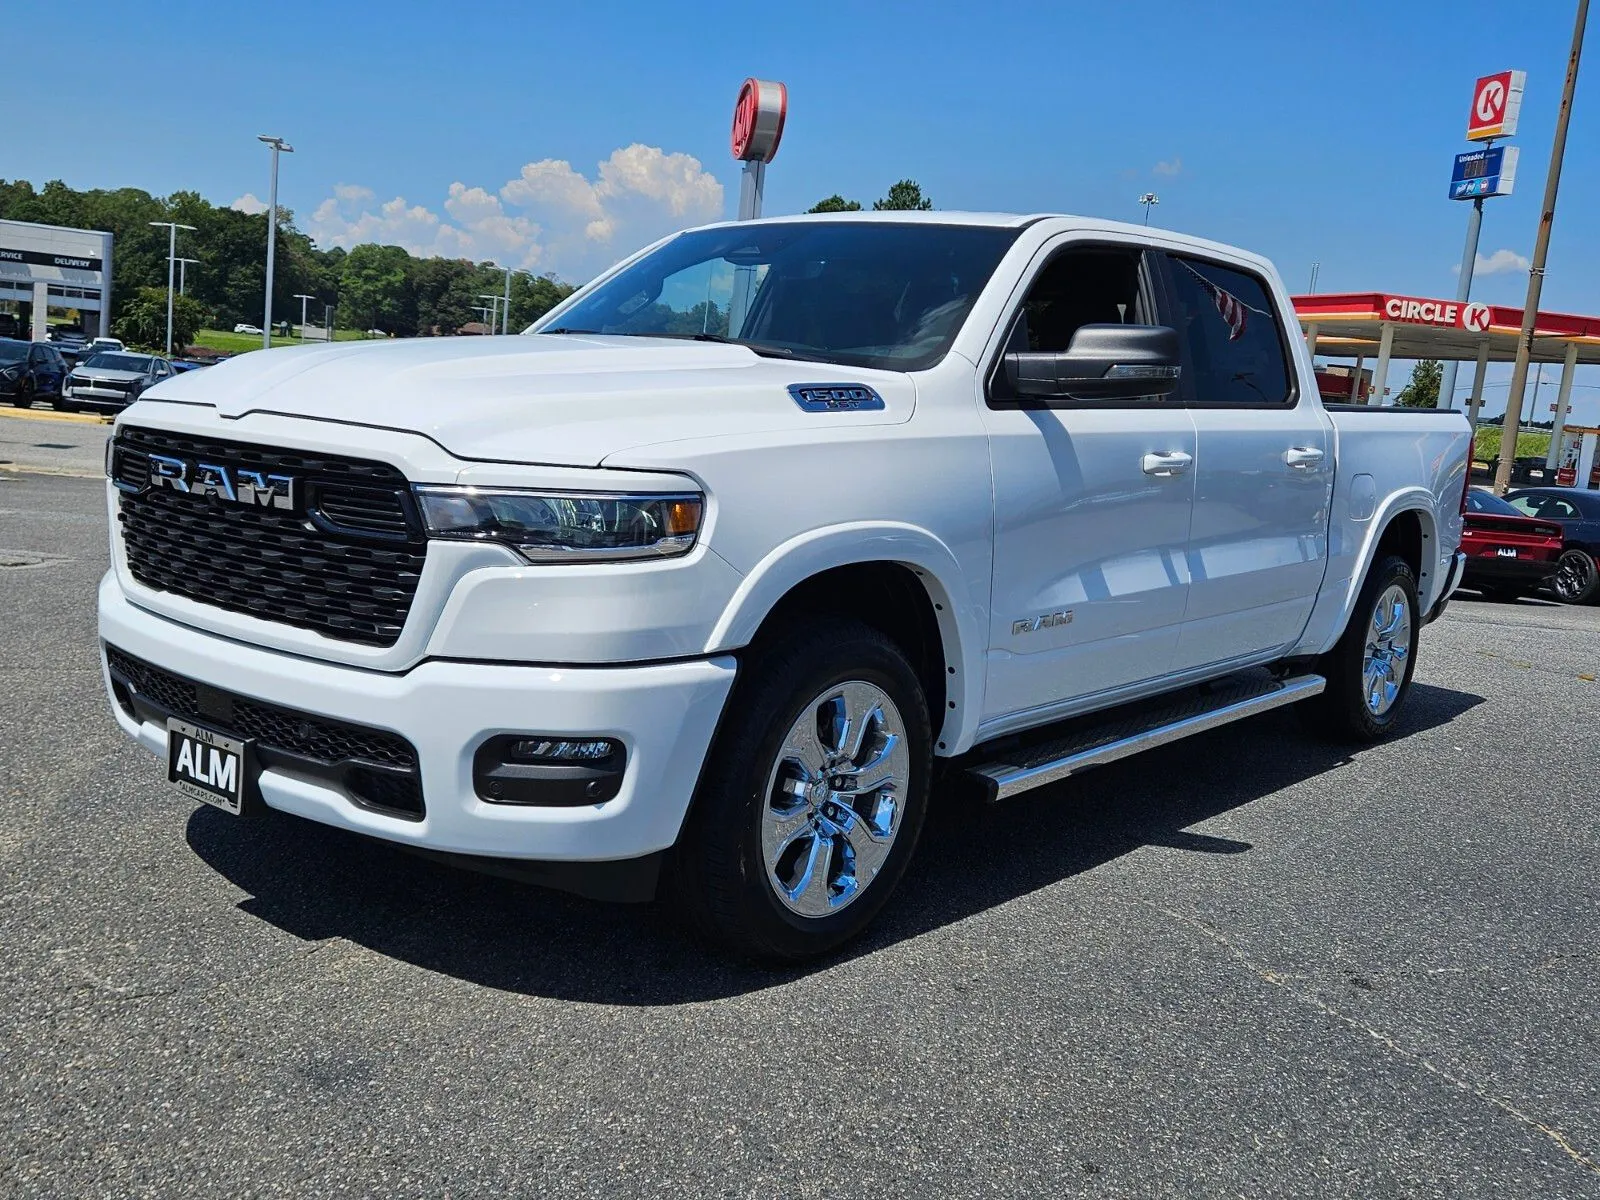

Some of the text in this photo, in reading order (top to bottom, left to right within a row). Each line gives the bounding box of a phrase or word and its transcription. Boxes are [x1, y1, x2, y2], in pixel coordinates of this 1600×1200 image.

[1459, 152, 1485, 163] Unleaded
[0, 251, 23, 260] RVICE
[54, 257, 91, 268] DELIVERY
[1386, 299, 1489, 331] CIRCLE K
[801, 389, 868, 402] 1500
[149, 453, 294, 511] RAM
[1497, 548, 1517, 558] ALM
[1012, 610, 1073, 636] RAM
[195, 728, 214, 745] ALM
[176, 738, 237, 793] ALM
